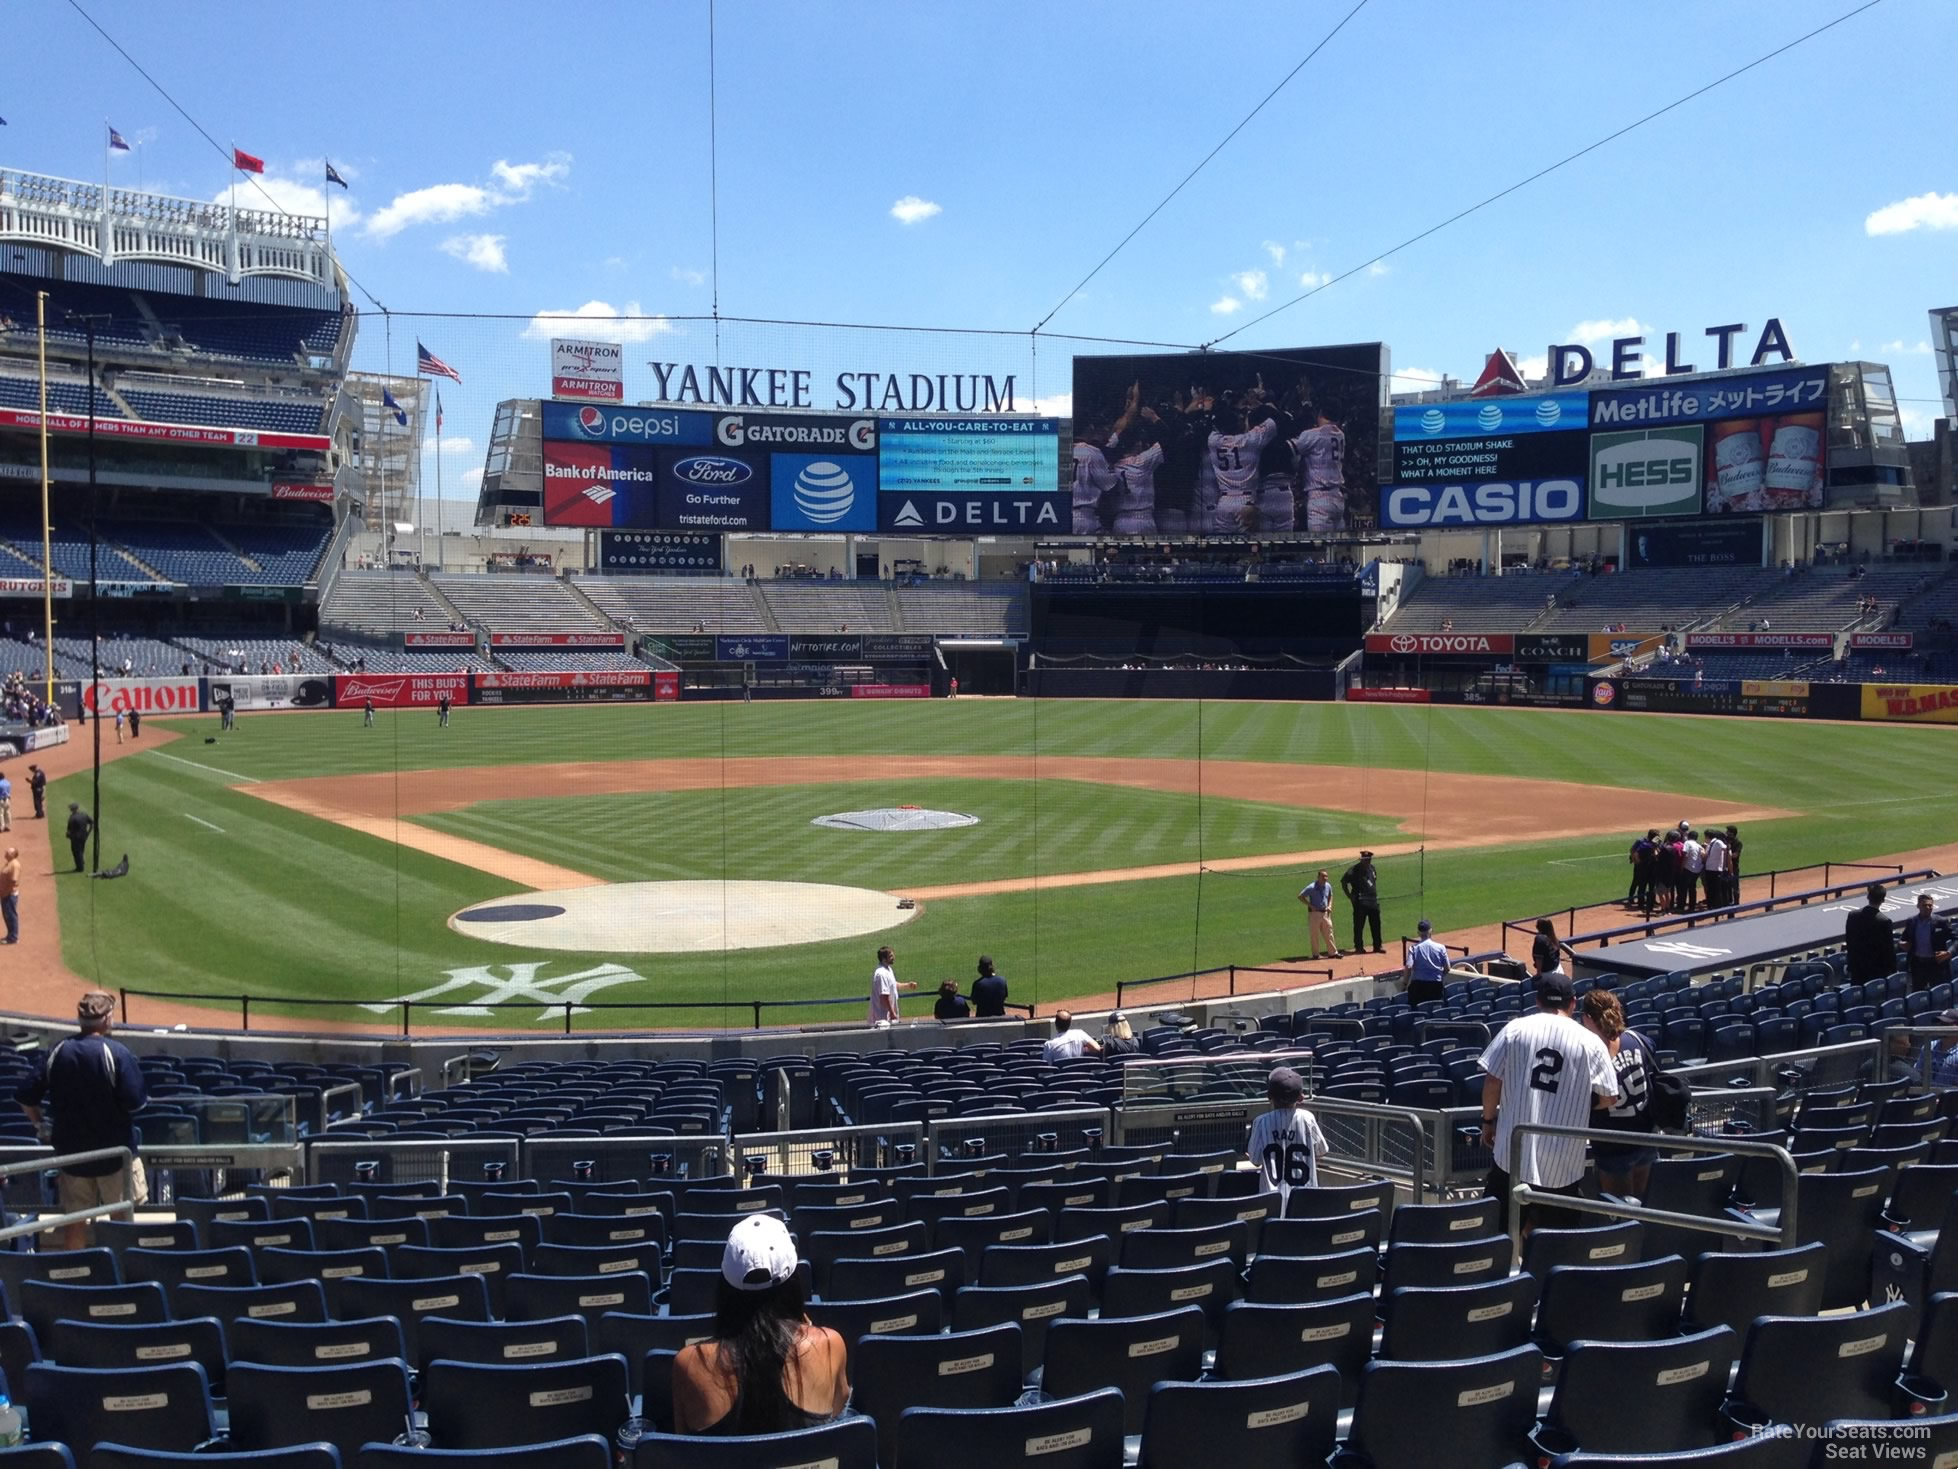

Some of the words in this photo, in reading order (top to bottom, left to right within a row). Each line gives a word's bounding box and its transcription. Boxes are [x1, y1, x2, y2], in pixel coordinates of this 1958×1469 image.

[557, 344, 619, 358] ARMITRON
[1554, 318, 1795, 386] DELTA
[560, 379, 617, 392] ARMITRON
[648, 362, 812, 409] YANKEE
[836, 372, 1017, 412] STADIUM
[1707, 379, 1826, 412] メットライフ
[1594, 390, 1700, 424] MetLife
[16, 415, 40, 426] MORE
[70, 420, 82, 428] OF
[122, 424, 146, 434] THAN
[148, 426, 168, 436] ANY
[170, 428, 200, 439] OTHER
[202, 431, 227, 441] TEAM
[239, 433, 255, 444] 22
[612, 416, 680, 439] pepsi
[904, 422, 1034, 432] ALL-YOU-CARE-TO-EAT
[747, 426, 846, 444] GATORADE
[1402, 446, 1424, 455] THAT
[1426, 444, 1442, 454] OLD
[1444, 442, 1484, 452] STADIUM
[1217, 447, 1243, 472] 51
[1416, 458, 1432, 466] OH,
[1434, 457, 1447, 465] MY
[1449, 454, 1498, 465] GOODNESS!
[545, 463, 580, 480] Bank
[582, 465, 596, 480] of
[596, 466, 653, 482] America
[688, 457, 738, 482] Ford
[1401, 469, 1424, 478] WHAT
[1428, 469, 1434, 477] A
[1436, 467, 1472, 476] MOMENT
[1475, 466, 1497, 474] HERE
[1600, 458, 1694, 488] HESS
[273, 484, 334, 500] Budweiser
[686, 494, 702, 504] Go
[703, 495, 740, 505] Further
[1388, 480, 1580, 524] CASIO
[679, 514, 748, 526] tristateford.com
[936, 502, 1059, 524] DELTA
[1688, 554, 1708, 562] THE
[1710, 552, 1736, 562] BOSS
[790, 642, 860, 652] NITTOTIRE.COM
[1420, 636, 1490, 651] TOYOTA
[1610, 640, 1636, 656] SAP
[1690, 636, 1736, 646] MODELL'S
[1754, 636, 1828, 646] MODELLS.com
[1856, 636, 1906, 646] MODELL'S
[1520, 646, 1581, 657] COACH
[1496, 664, 1520, 673] FedEx
[343, 681, 403, 698] Budweiser
[411, 678, 428, 689] THIS
[430, 678, 466, 689] BUD'S
[1703, 682, 1728, 692] pepsi
[84, 682, 197, 714] Canon
[411, 690, 430, 701] FOR
[432, 690, 456, 701] YOU.
[1530, 1047, 1564, 1094] 2
[1272, 1130, 1296, 1142] RAO
[1262, 1143, 1311, 1187] 06
